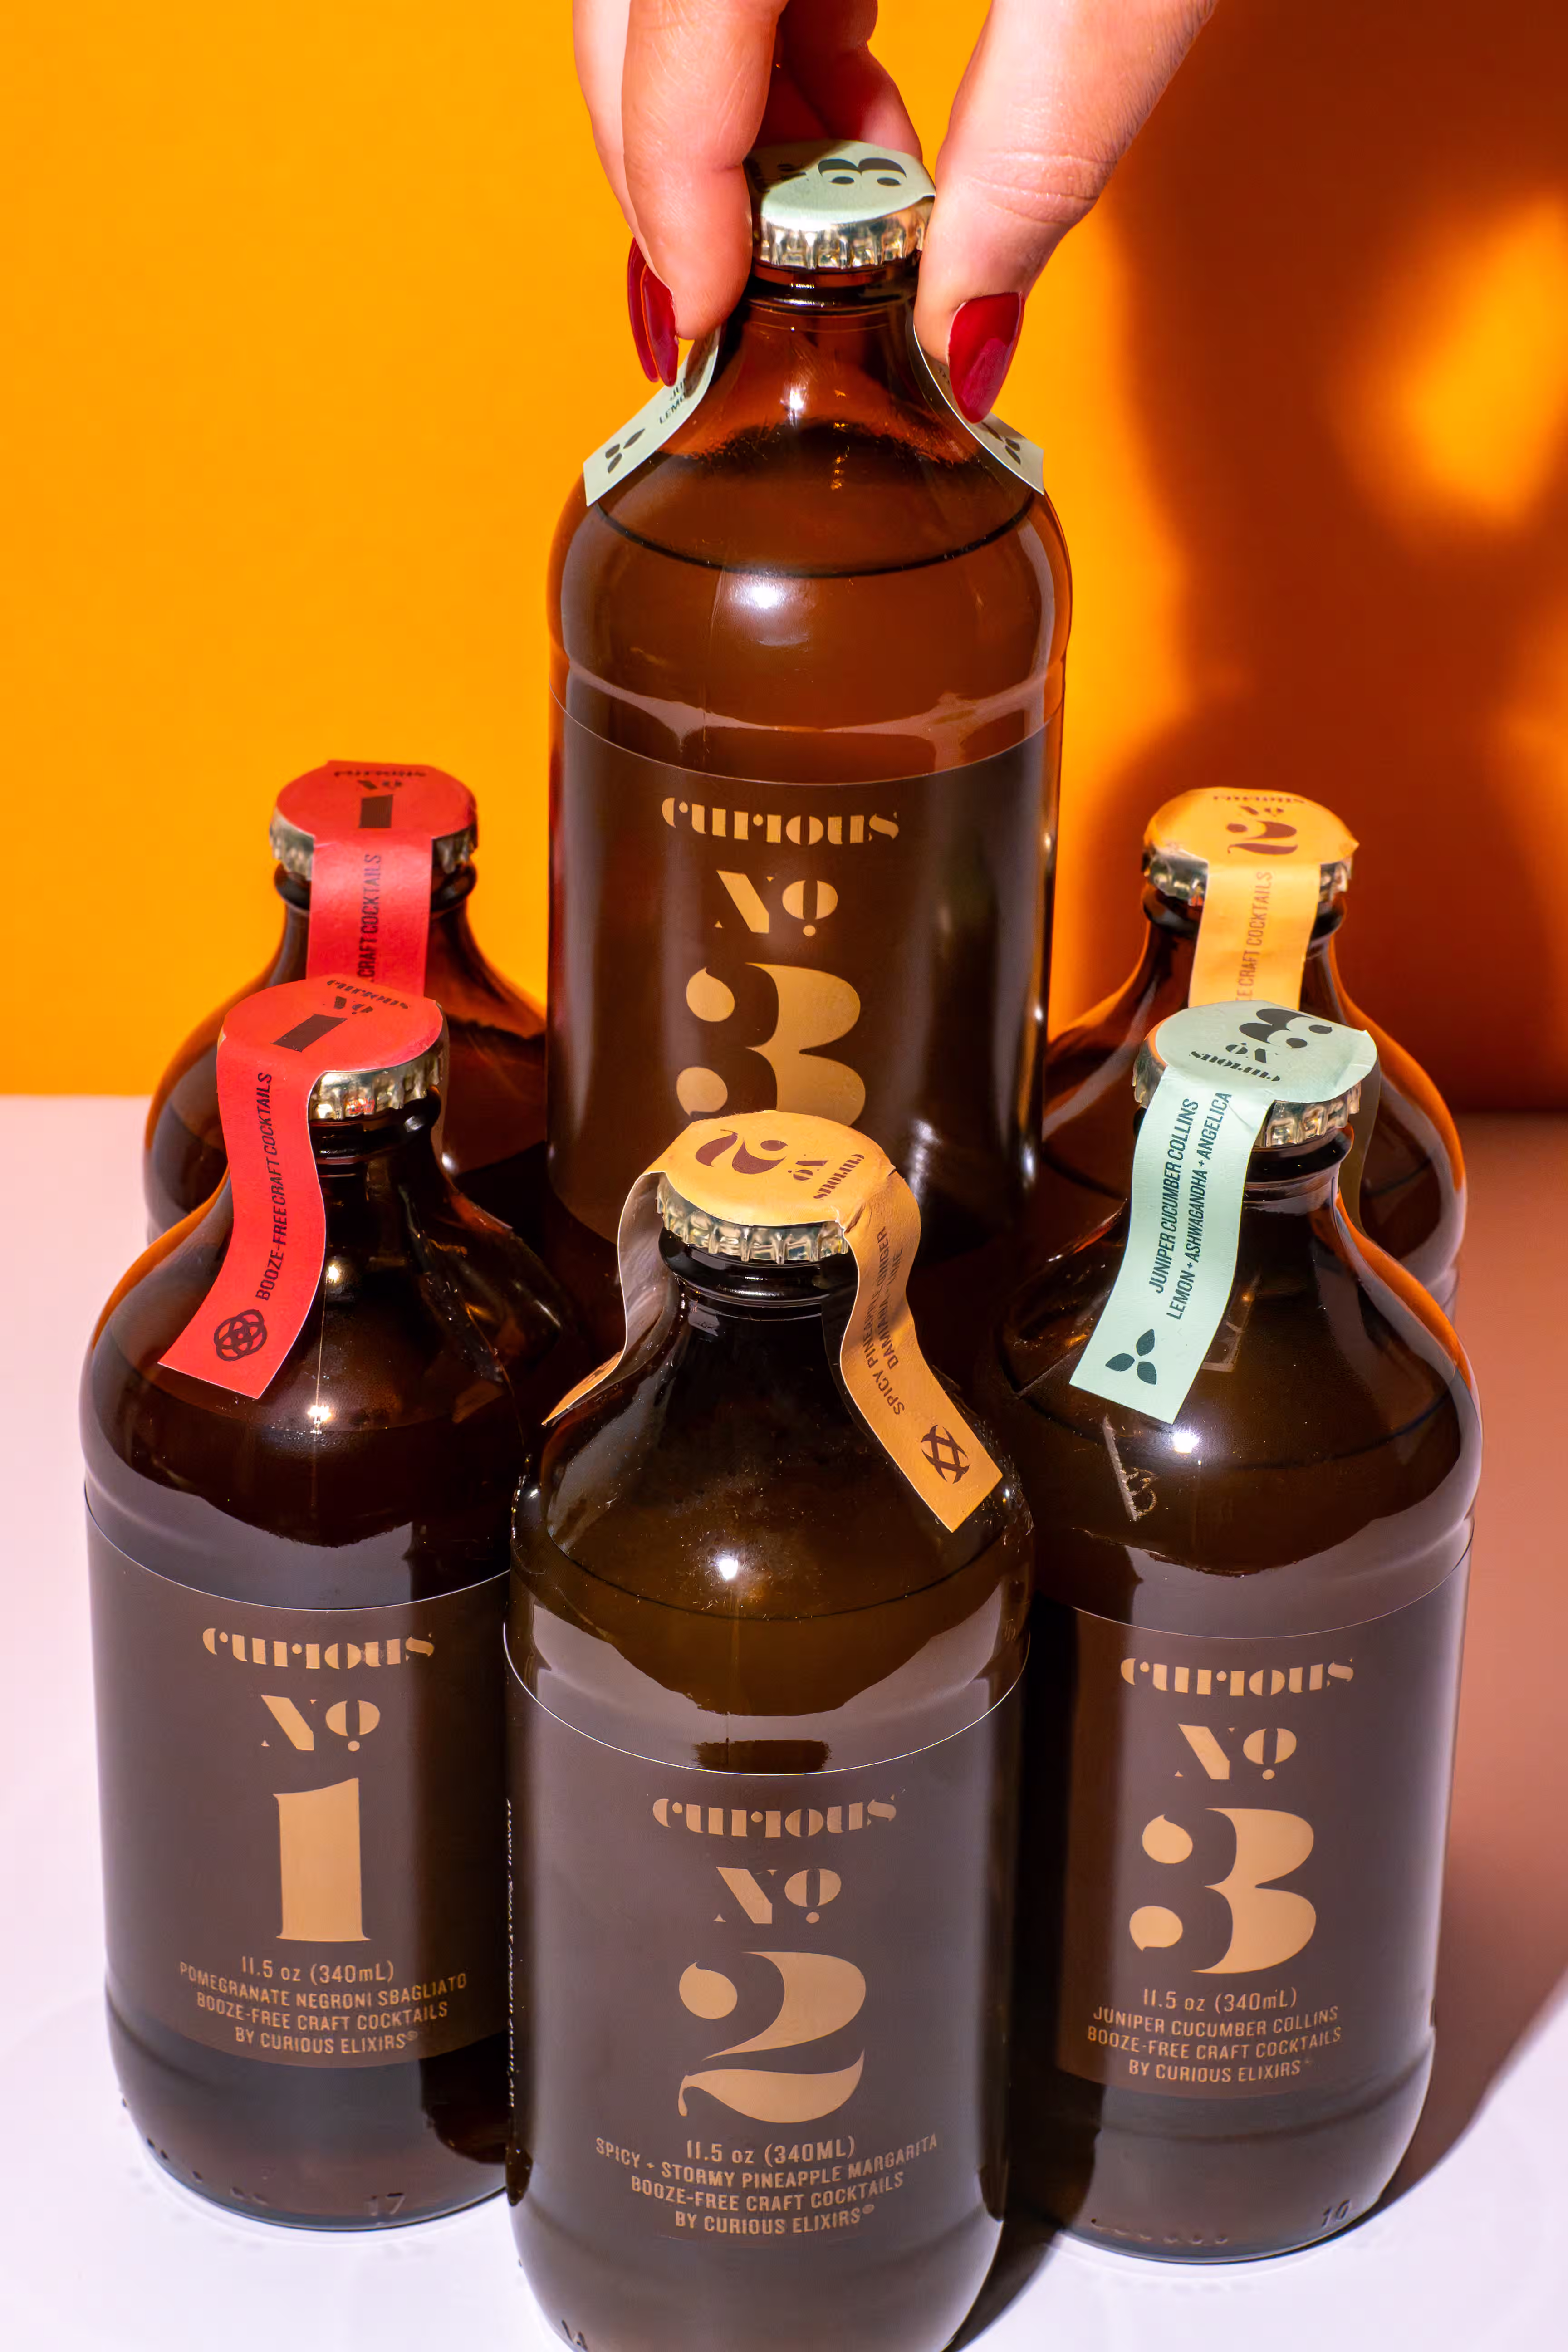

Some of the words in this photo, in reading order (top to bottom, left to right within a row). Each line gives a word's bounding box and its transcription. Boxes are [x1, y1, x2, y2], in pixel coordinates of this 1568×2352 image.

[1226, 820, 1298, 856] 2
[361, 854, 381, 934] COCKTAILS
[1246, 871, 1273, 946] COCKTAILS
[357, 936, 377, 977] CRAFT
[1238, 950, 1260, 986] CRAFT
[676, 962, 866, 1127] 3
[1239, 1008, 1333, 1049] 3
[256, 1072, 277, 1156] COCKTAILS
[1167, 1098, 1198, 1161] COLLINS
[695, 1129, 788, 1174] 2
[266, 1156, 286, 1205] CRAFT
[1161, 1161, 1181, 1232] CUCUMBER
[1166, 1270, 1195, 1320] LEMON
[1185, 1169, 1207, 1263] ASHWAGANDHA
[1196, 1092, 1232, 1160] ANGELICA
[255, 1205, 287, 1301] BOOZE-FREE
[1149, 1232, 1176, 1294] JUNIPER
[872, 1370, 905, 1415] SPICY
[202, 1627, 434, 1669] curious
[1120, 1657, 1354, 1696] curious
[652, 1794, 897, 1838] curious
[273, 1777, 371, 1942] 1
[1129, 1808, 1316, 1974] 3
[180, 1961, 291, 2007] POMEGRANATE
[296, 1992, 372, 2009] NEGRONI
[377, 1973, 467, 2006] SBAGLIATO
[242, 1956, 273, 1978] 11.5
[280, 1967, 301, 1981] oz
[310, 1960, 394, 1986] (340mL)
[196, 1992, 291, 2029] BOOZE-FREE
[297, 2014, 351, 2031] CRAFT
[357, 2001, 448, 2030] COCKTAILS
[1093, 2006, 1165, 2034] JUNIPER
[1171, 2020, 1267, 2038] CUCUMBER
[1273, 2005, 1338, 2034] COLLINS
[1143, 1988, 1176, 2009] 11.5
[1184, 1997, 1205, 2012] oz
[1214, 1986, 1297, 2014] (340mL)
[235, 2026, 255, 2044] BY
[260, 2032, 334, 2054] CURIOUS
[678, 1951, 866, 2124] 2
[1087, 2025, 1190, 2059] BOOZE-FREE
[1196, 2043, 1251, 2060] CRAFT
[1256, 2026, 1342, 2058] COCKTAILS
[1129, 2059, 1150, 2077] BY
[1156, 2064, 1231, 2083] CURIOUS
[595, 2137, 640, 2168] SPICY
[661, 2161, 735, 2188] STORMY
[742, 2166, 843, 2189] PINEAPPLE
[848, 2133, 937, 2179] MARGARITA
[687, 2140, 723, 2163] 11.5
[731, 2150, 755, 2164] oz
[764, 2135, 855, 2167] (340ML)
[631, 2175, 740, 2211] BOOZE-FREE
[746, 2194, 805, 2211] CRAFT
[810, 2171, 904, 2209] COCKTAILS
[676, 2210, 697, 2229] BY
[704, 2215, 785, 2234] CURIOUS
